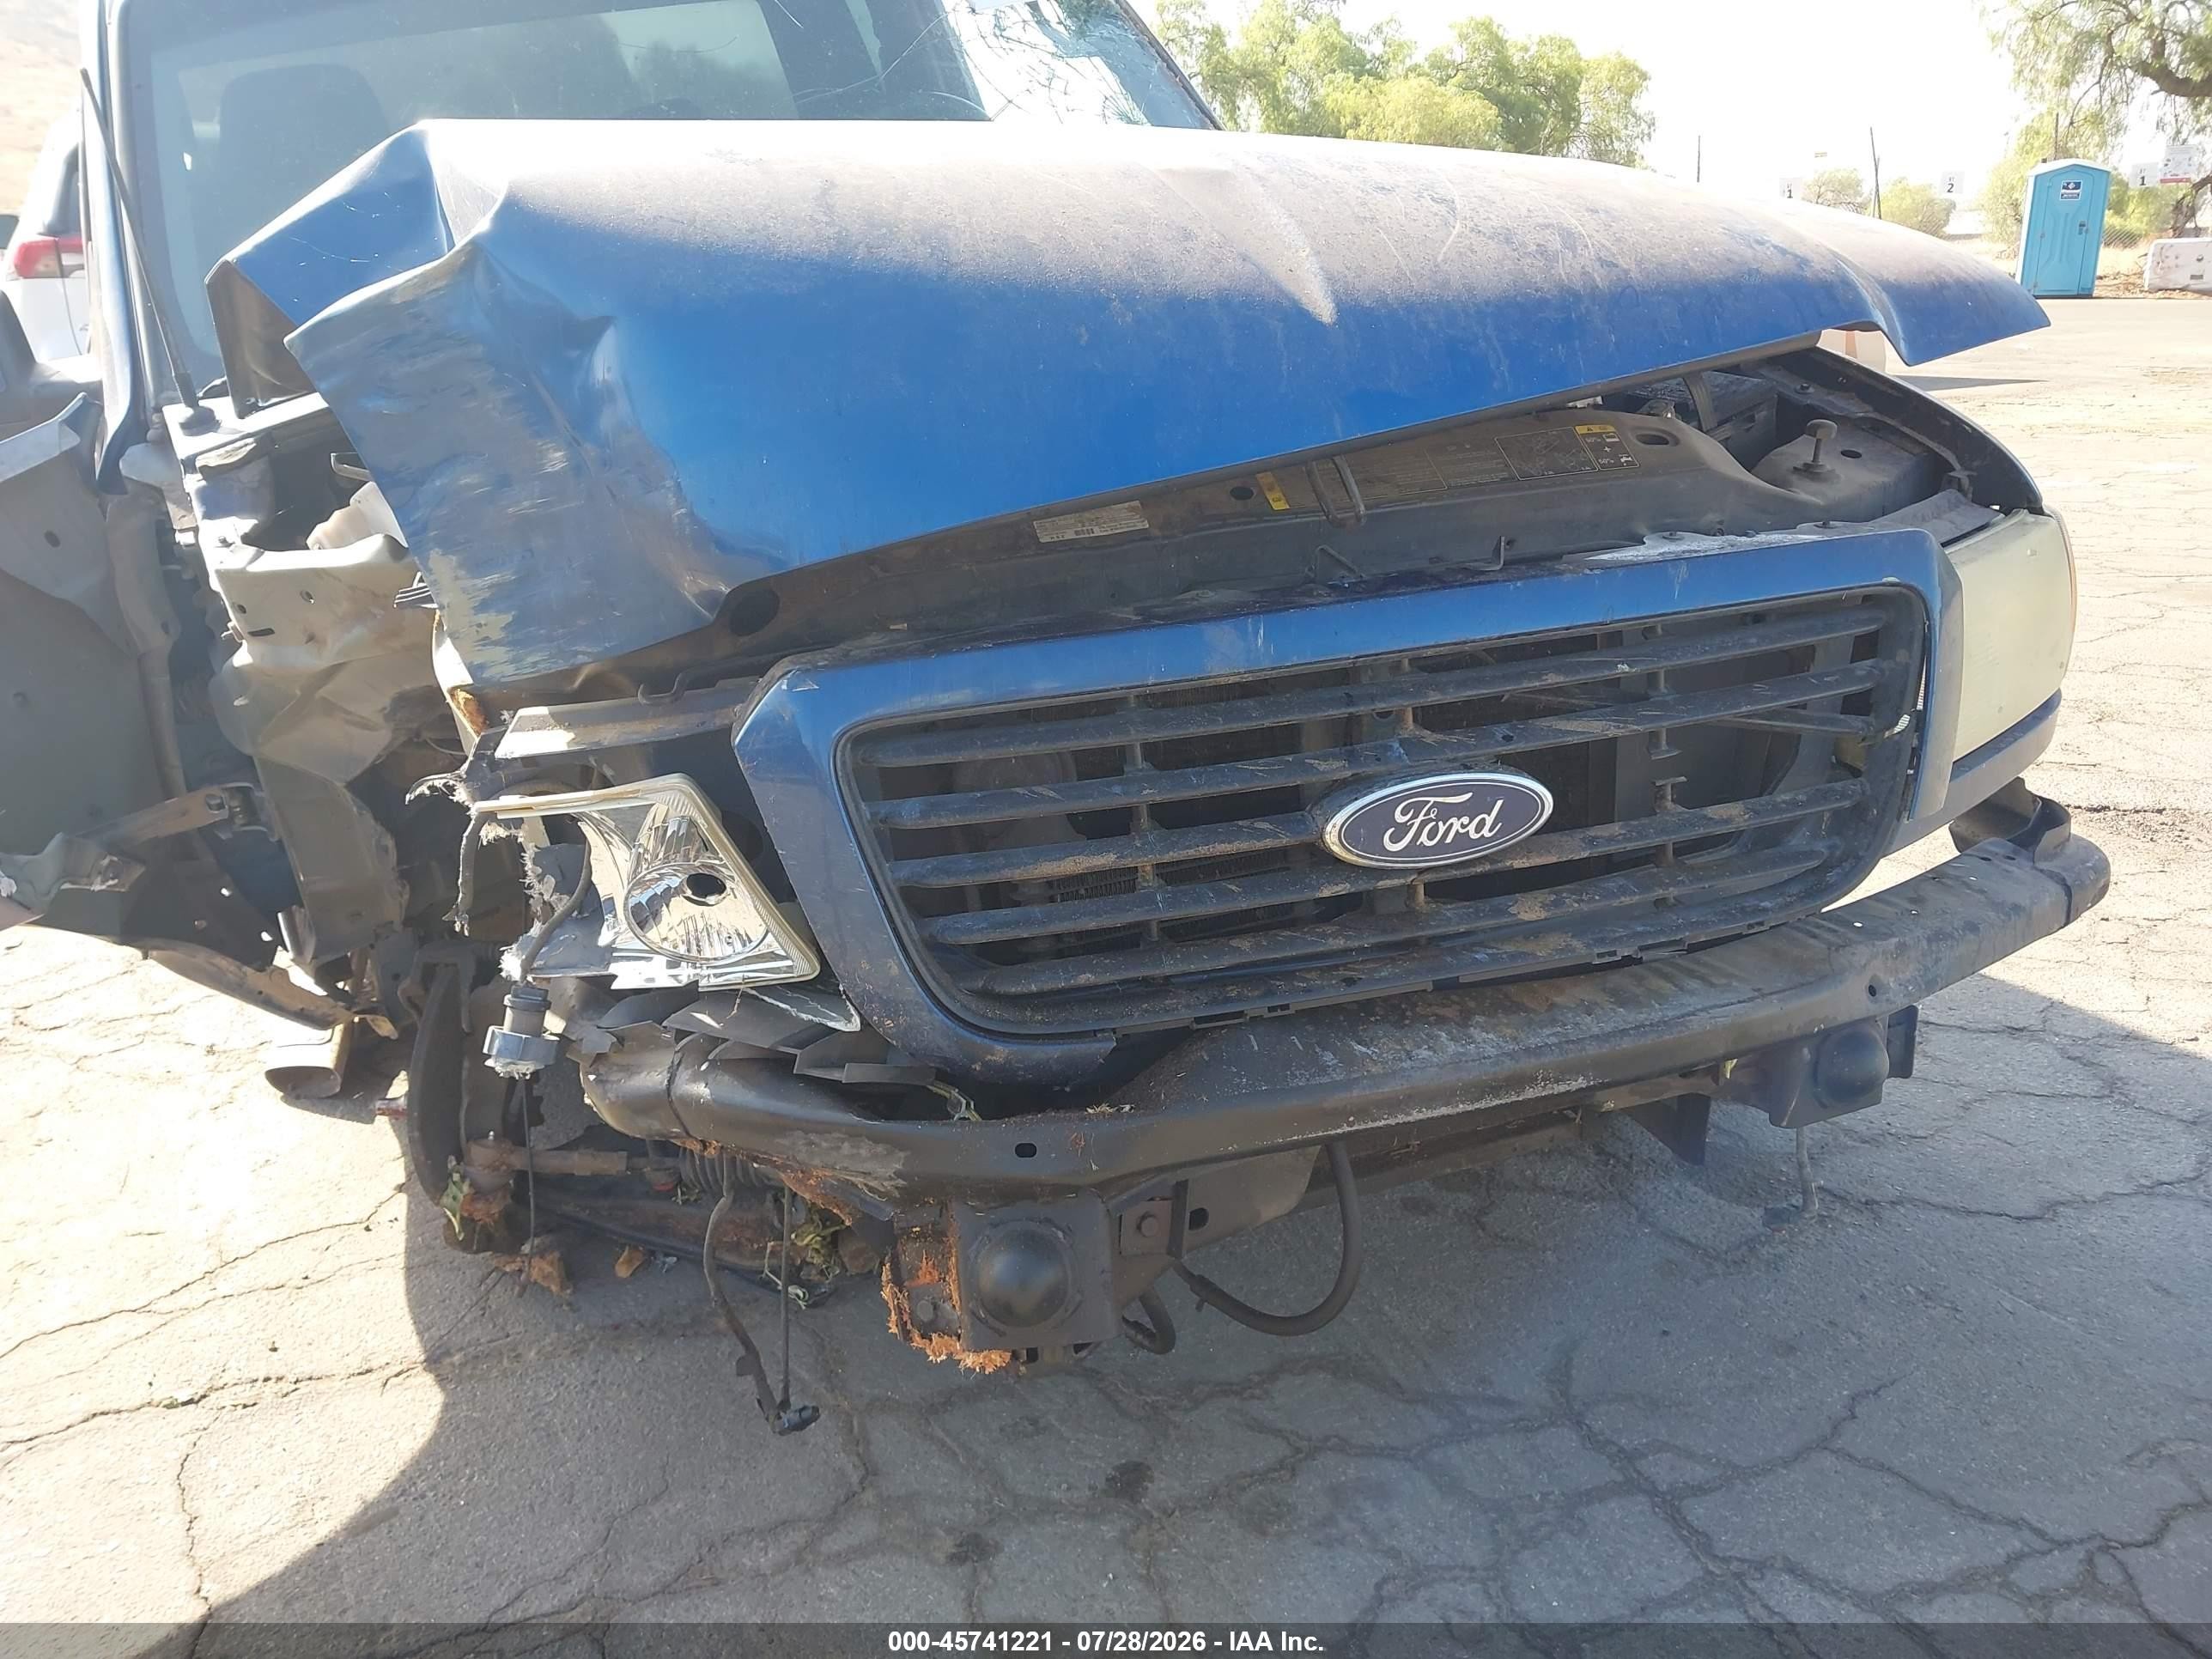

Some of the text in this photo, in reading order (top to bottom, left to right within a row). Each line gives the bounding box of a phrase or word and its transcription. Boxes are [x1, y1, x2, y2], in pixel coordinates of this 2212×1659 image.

[2139, 175, 2147, 186] 1
[1786, 188, 1794, 198] 1
[1947, 182, 1954, 193] 2
[1382, 791, 1505, 853] Ford
